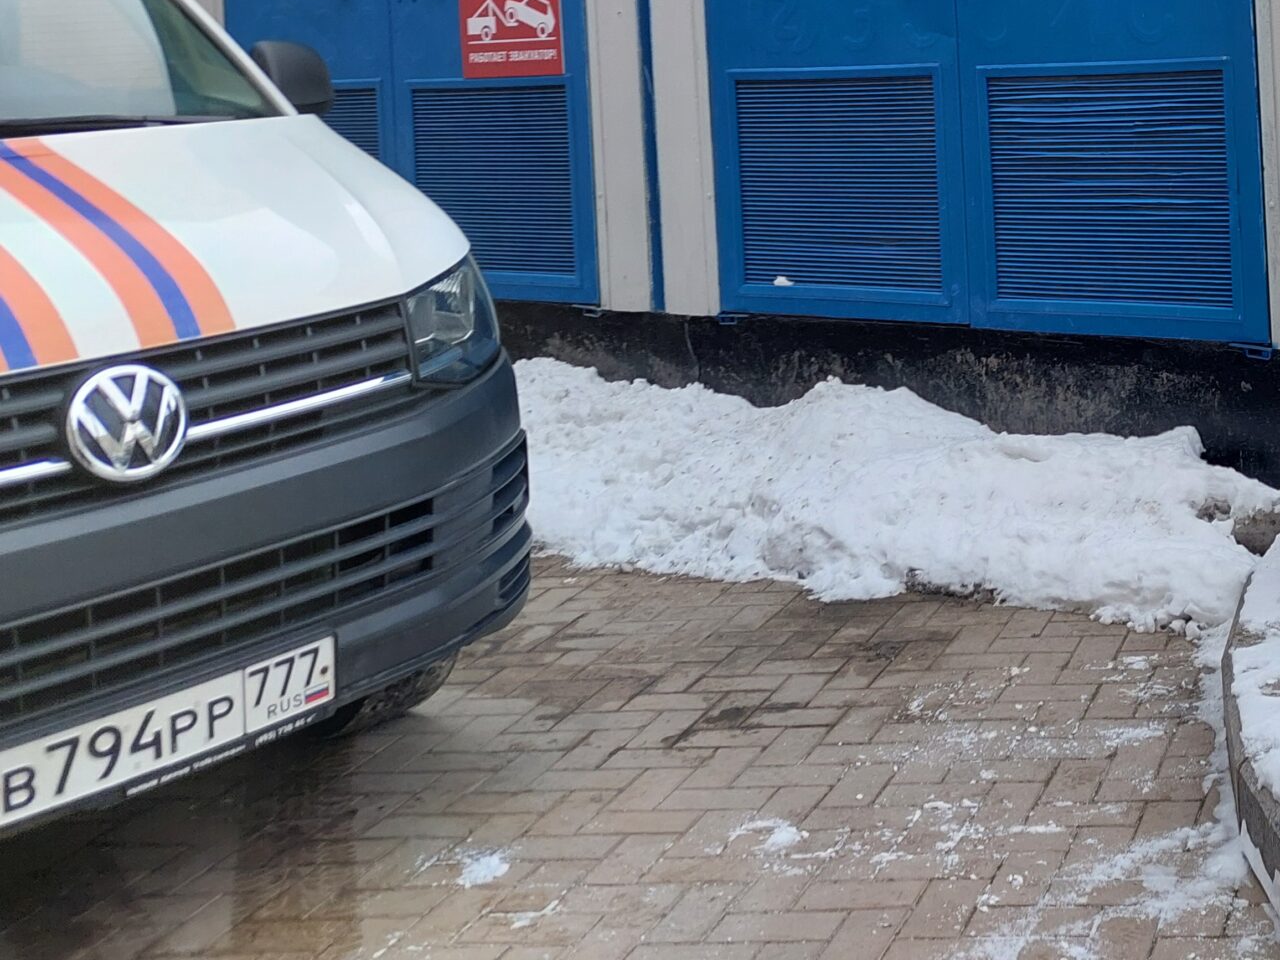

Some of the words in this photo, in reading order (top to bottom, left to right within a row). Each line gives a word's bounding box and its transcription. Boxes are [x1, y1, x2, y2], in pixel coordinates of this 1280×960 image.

[468, 51, 507, 64] РАБОТАЕТ
[248, 645, 320, 708] 777
[267, 693, 303, 720] RUS
